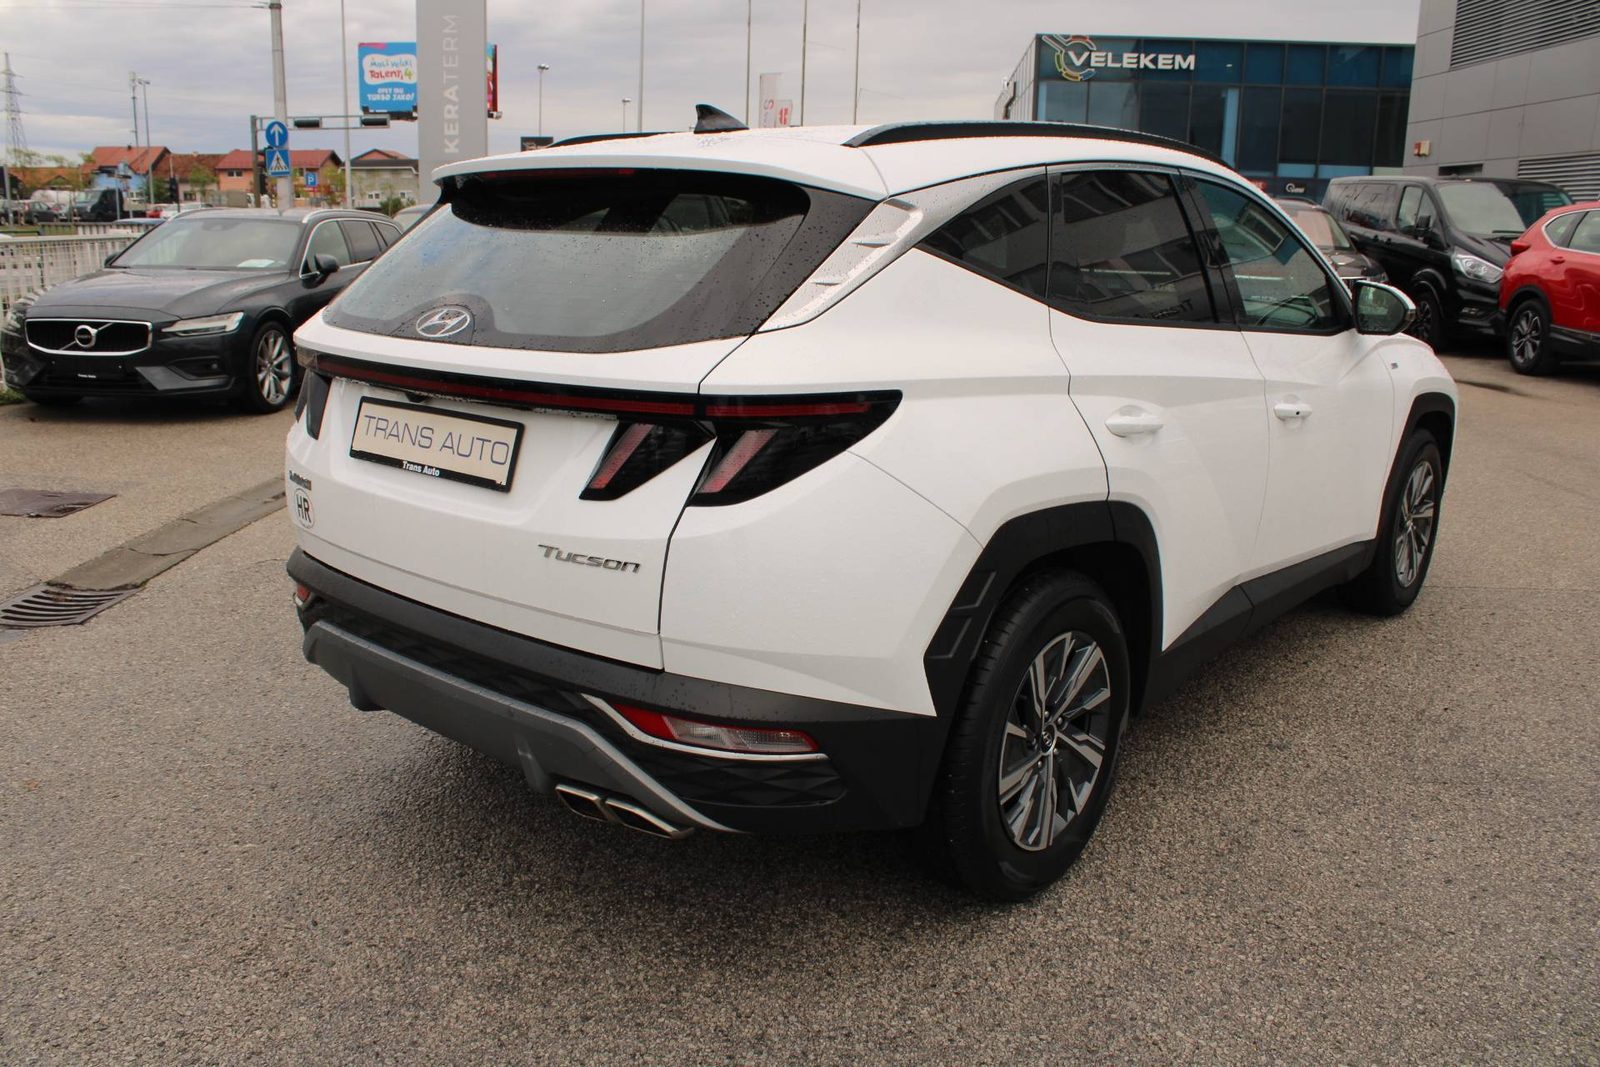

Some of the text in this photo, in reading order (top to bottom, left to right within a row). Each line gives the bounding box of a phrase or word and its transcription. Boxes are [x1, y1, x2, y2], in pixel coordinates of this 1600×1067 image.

[404, 67, 413, 80] 4
[1068, 51, 1196, 71] VELEKEM
[443, 14, 461, 154] KERATERM
[363, 414, 510, 466] TRANS AUTO
[402, 460, 441, 477] Trans Auto
[296, 493, 312, 524] HR
